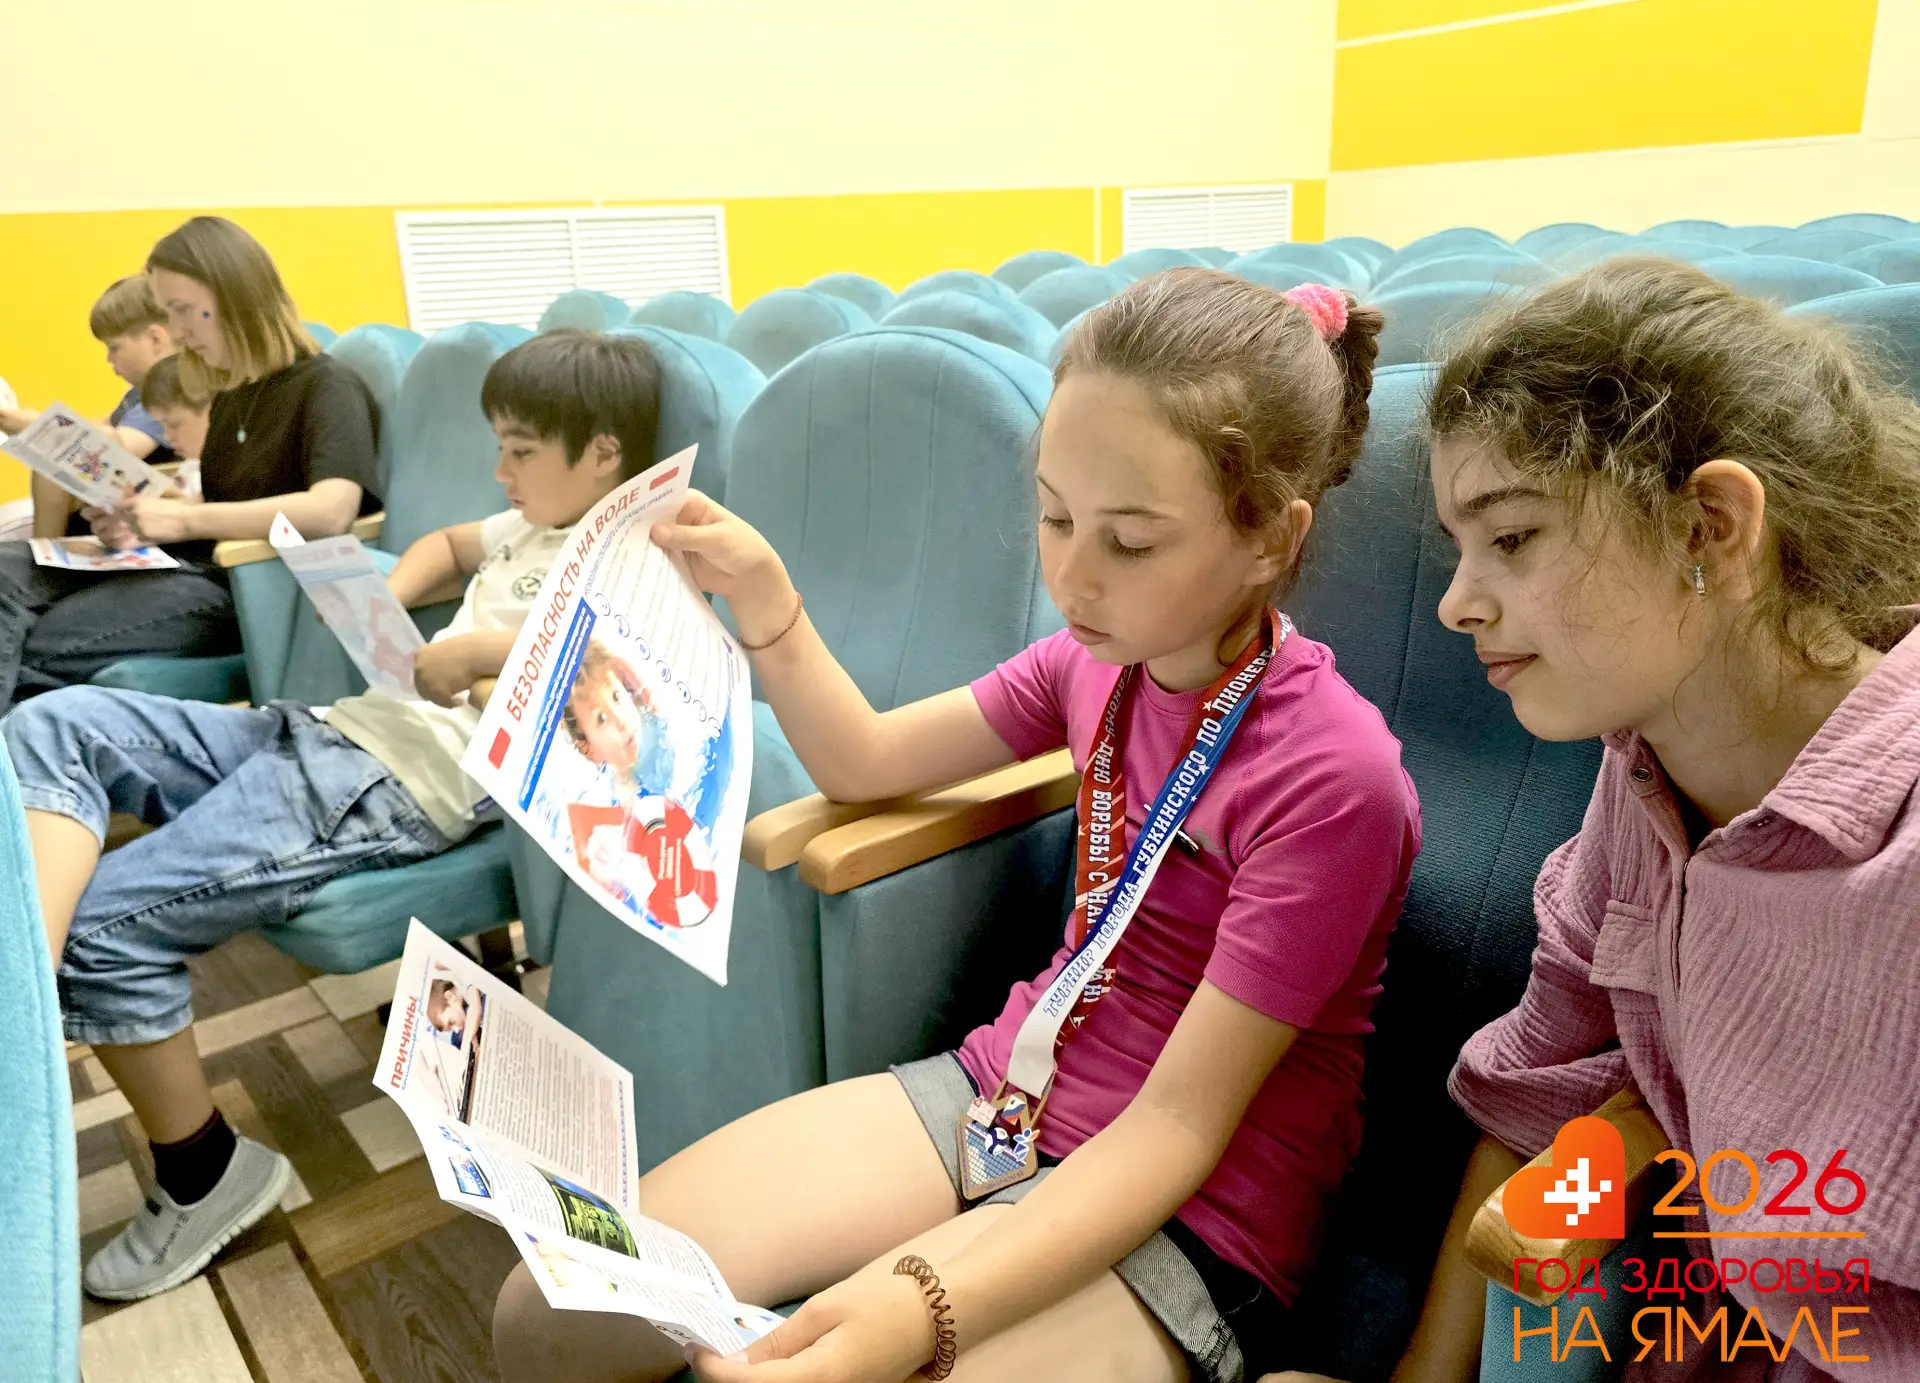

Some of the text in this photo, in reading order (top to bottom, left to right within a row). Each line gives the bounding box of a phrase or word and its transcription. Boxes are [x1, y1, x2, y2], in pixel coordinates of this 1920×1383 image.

[506, 560, 580, 721] БЕЗОПАСНОСТЬ
[576, 530, 596, 561] НА
[594, 486, 641, 535] ВОДЕ
[1093, 741, 1114, 784] ДНЮ
[1088, 789, 1112, 863] БОРЬБЫ
[1043, 948, 1095, 1019] ТУРНИР
[1094, 881, 1140, 950] ГОРОДА
[1132, 749, 1207, 879] ГУБКИНСКОГО
[1196, 717, 1222, 748] ПО
[1088, 870, 1109, 883] С
[390, 996, 417, 1089] ПРИЧИНЫ
